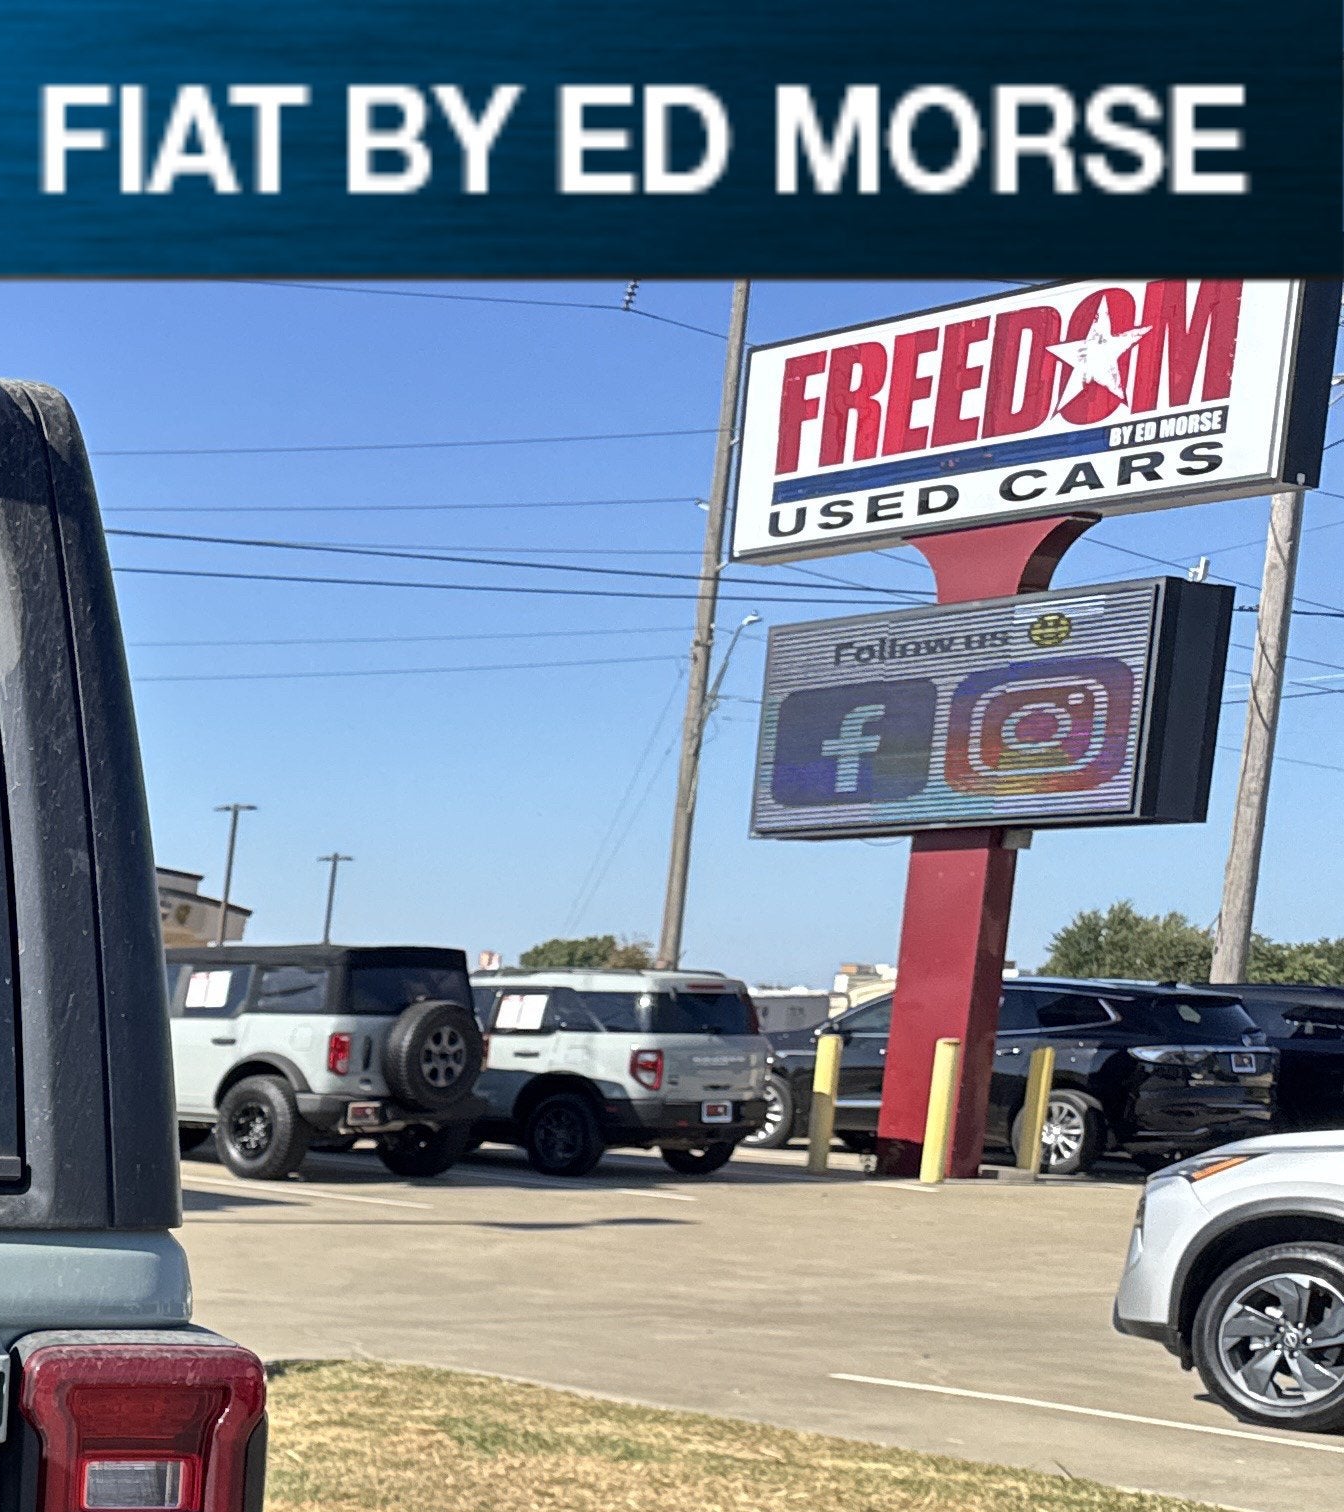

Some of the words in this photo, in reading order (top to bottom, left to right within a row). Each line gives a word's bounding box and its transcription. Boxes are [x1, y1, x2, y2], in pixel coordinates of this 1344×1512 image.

[774, 279, 1244, 475] FREEDOM
[1109, 425, 1133, 447] BY
[1134, 421, 1157, 443] ED
[1159, 410, 1223, 438] MORSE
[768, 484, 959, 538] USED
[999, 441, 1224, 502] CARS
[834, 637, 955, 667] Follow
[964, 632, 1010, 651] us
